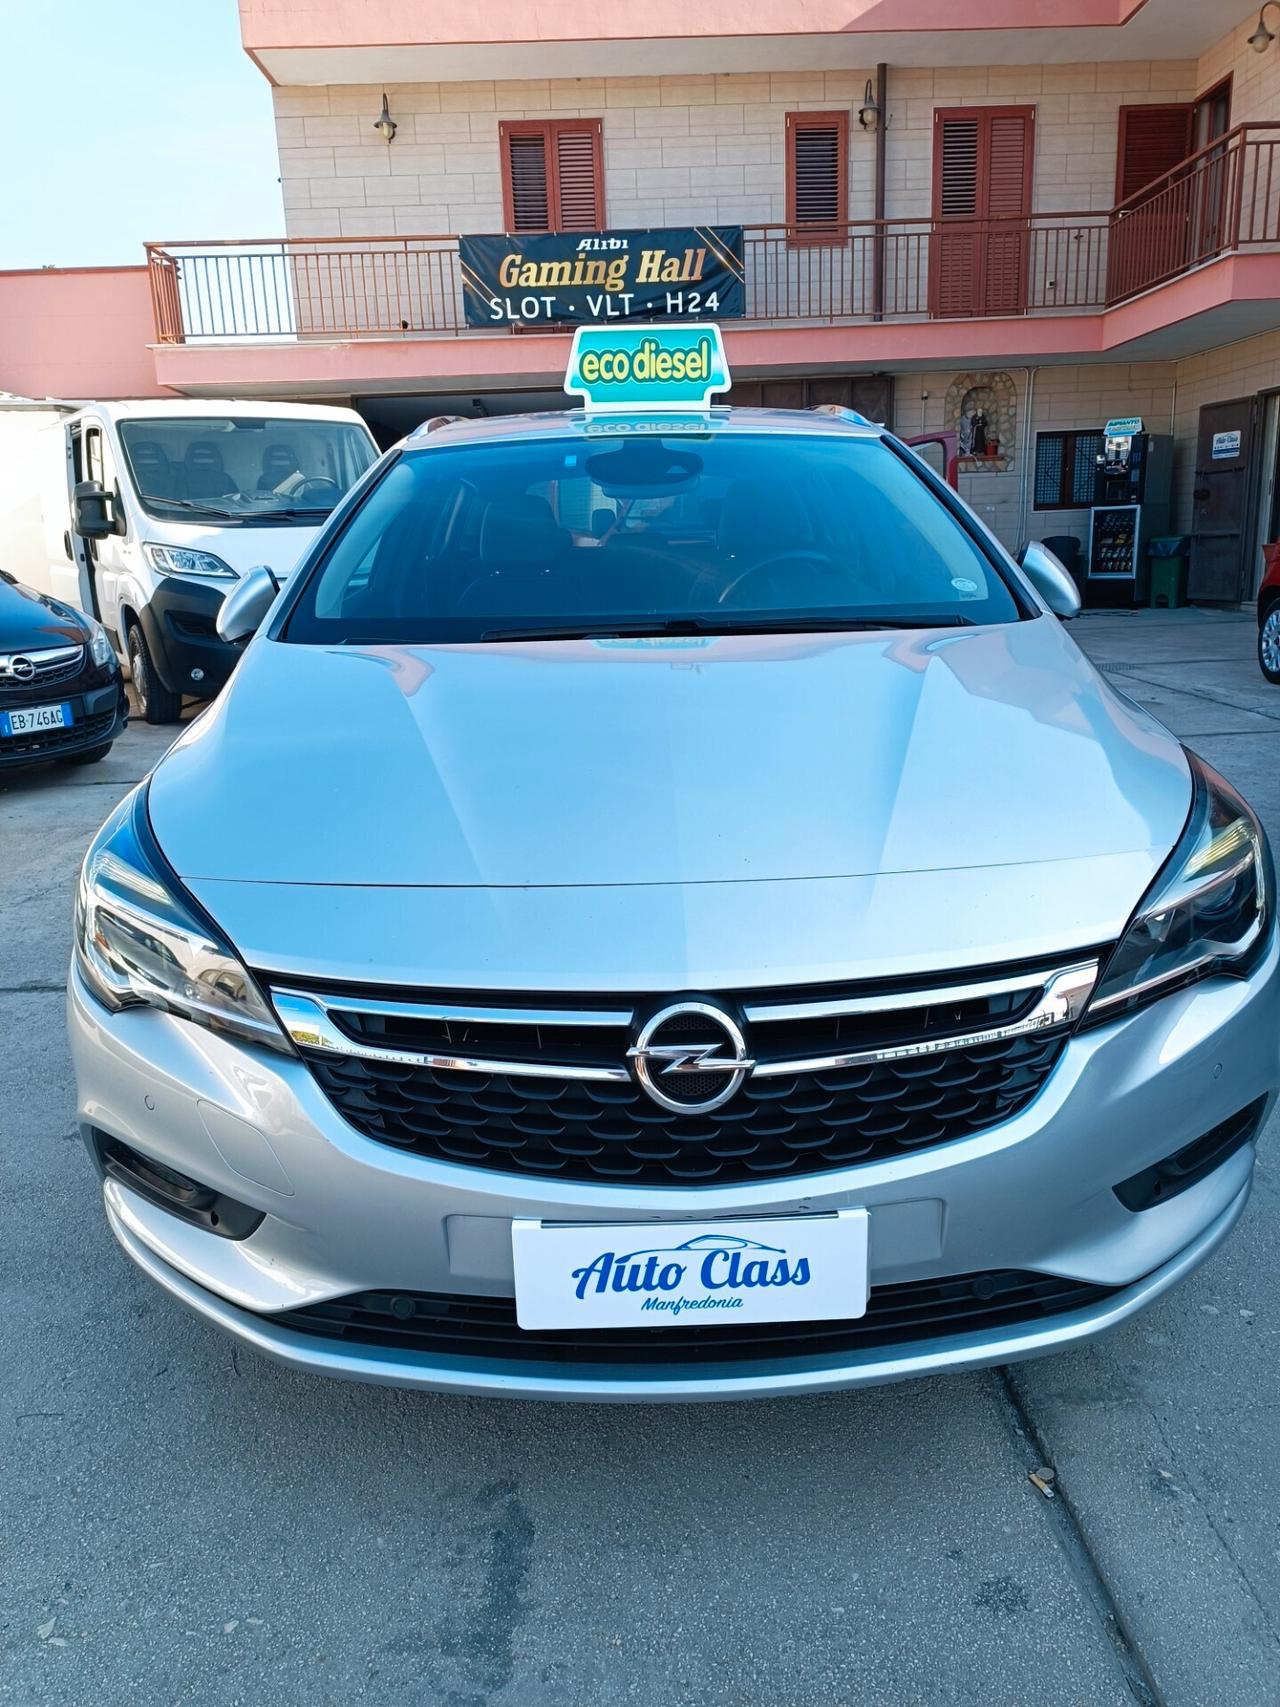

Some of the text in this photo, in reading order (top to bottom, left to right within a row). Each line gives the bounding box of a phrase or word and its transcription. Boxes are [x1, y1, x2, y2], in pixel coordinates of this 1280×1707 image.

[576, 237, 628, 250] Alibi
[499, 248, 706, 292] Gaming Hall
[490, 291, 720, 320] SLOT VLT H24
[582, 341, 708, 381] eco diesel
[10, 714, 26, 730] EB
[571, 1249, 811, 1299] Auto Class
[641, 1295, 743, 1316] Manfredonia
